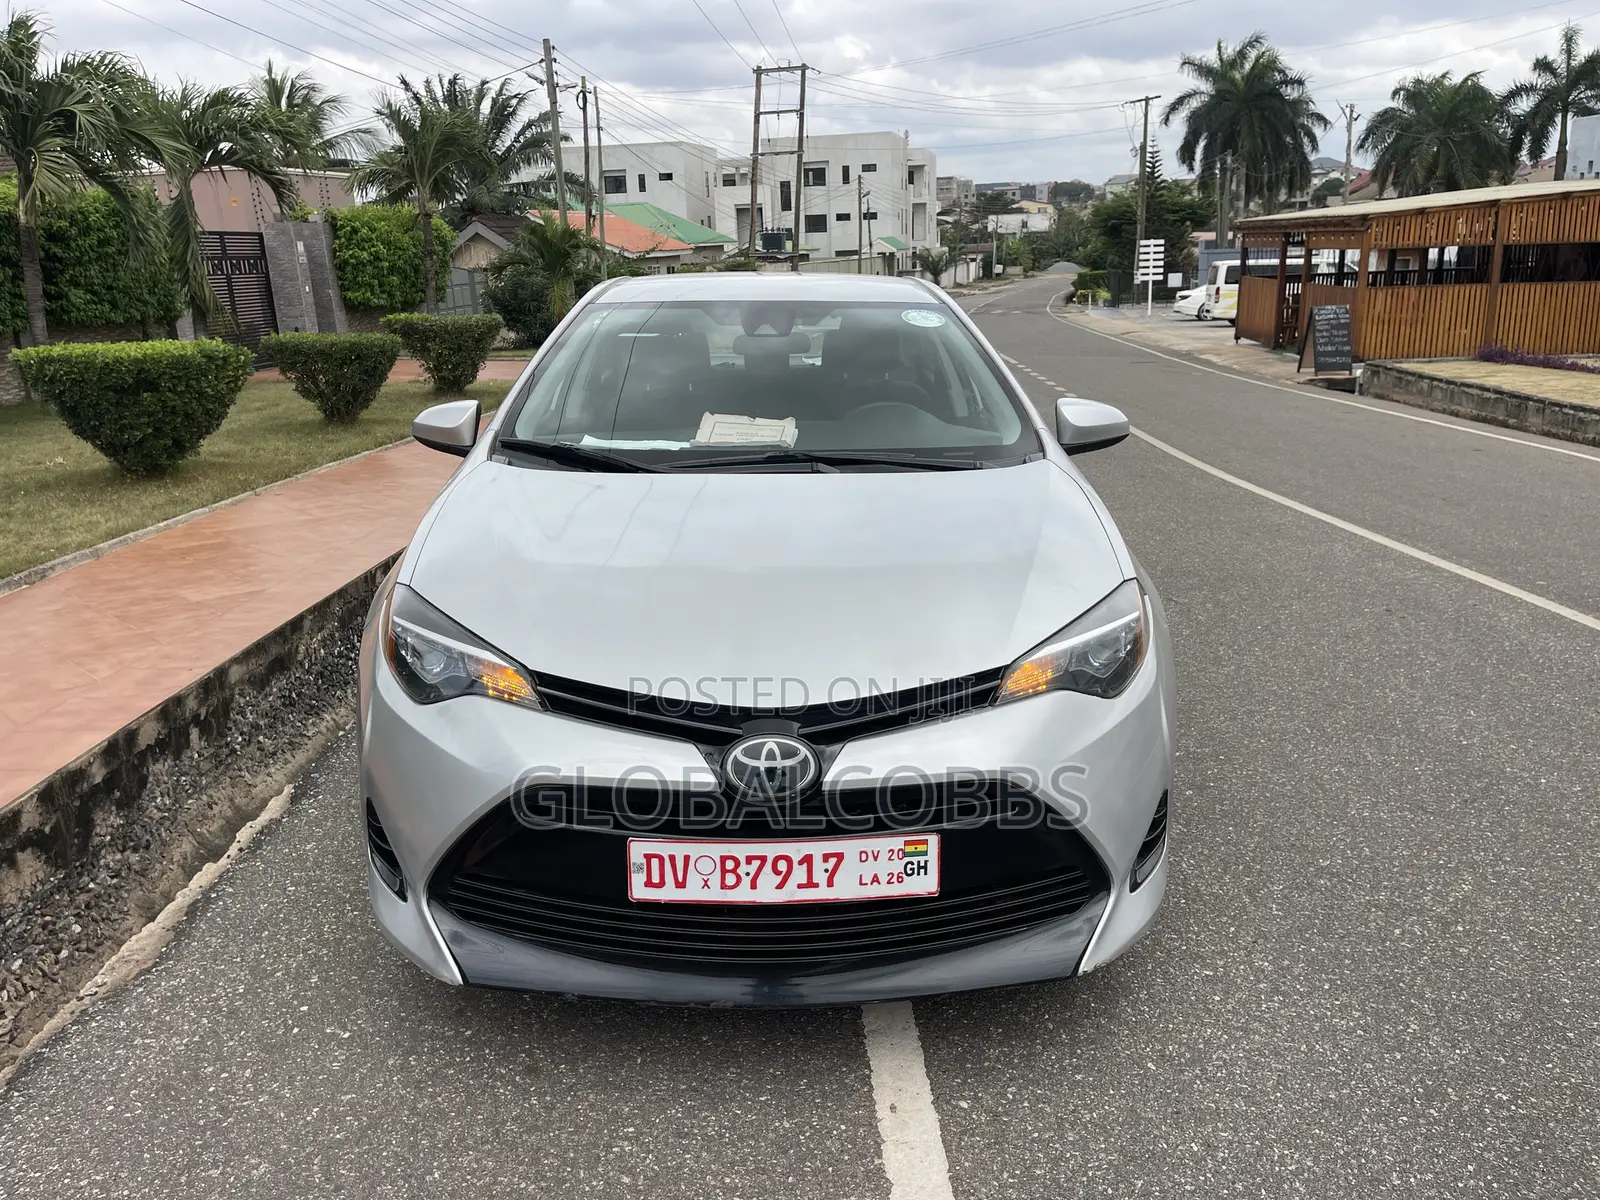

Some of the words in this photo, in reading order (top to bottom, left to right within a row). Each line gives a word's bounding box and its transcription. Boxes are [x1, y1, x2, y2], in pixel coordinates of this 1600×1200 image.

[859, 849, 881, 863] DV
[887, 847, 905, 862] 20
[643, 853, 691, 889] DV
[720, 852, 845, 890] B7917
[903, 860, 929, 878] GH
[858, 873, 881, 886] LA
[886, 871, 905, 885] 26
